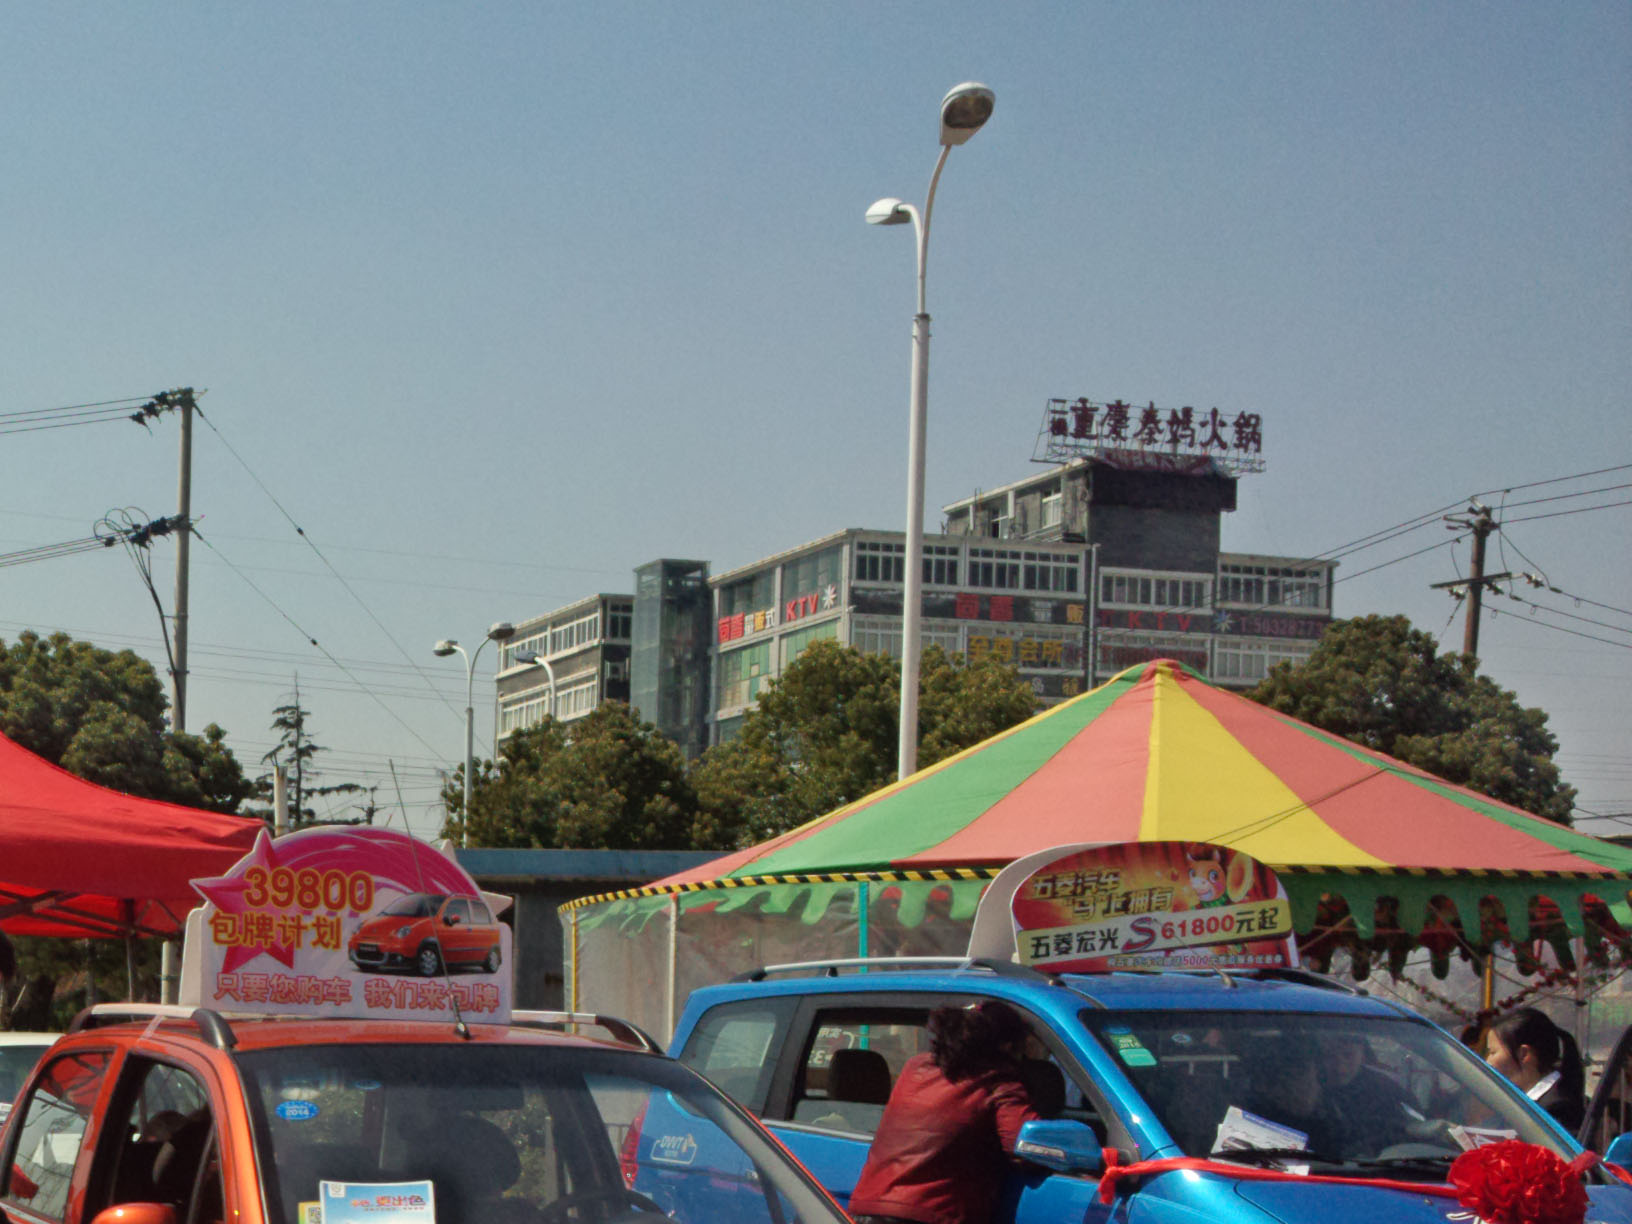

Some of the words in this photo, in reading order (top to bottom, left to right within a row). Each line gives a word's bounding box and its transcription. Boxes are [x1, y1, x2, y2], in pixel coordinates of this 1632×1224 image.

[785, 593, 819, 621] KTV
[243, 864, 375, 912] 39800
[209, 911, 343, 950] 包牌计划
[215, 973, 352, 1006] 只要您购车
[364, 978, 500, 1013] 我们来包牌
